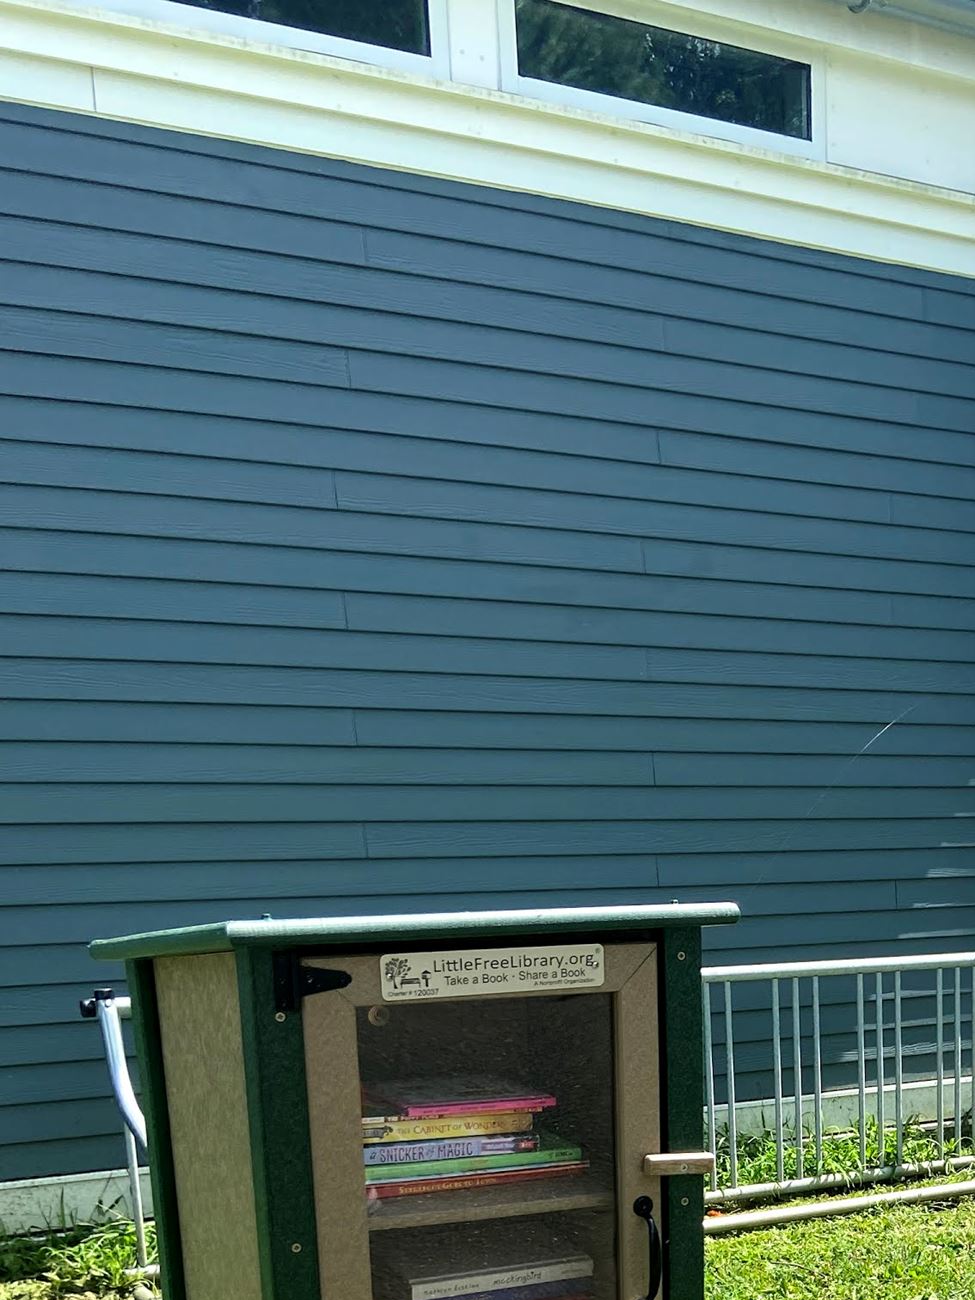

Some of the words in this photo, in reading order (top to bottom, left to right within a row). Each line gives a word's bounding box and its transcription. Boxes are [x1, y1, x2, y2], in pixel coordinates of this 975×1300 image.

[433, 954, 594, 973] LittleFreeLibrary.org
[444, 975, 469, 986] Take
[472, 976, 479, 984] a
[482, 973, 509, 984] Book
[518, 970, 549, 980] Share
[560, 968, 586, 978] Book
[413, 1125, 450, 1134] CABINET
[370, 1152, 376, 1160] a
[380, 1146, 424, 1162] SNICKER
[438, 1142, 473, 1158] MAGIC
[492, 1272, 542, 1286] mockingbird
